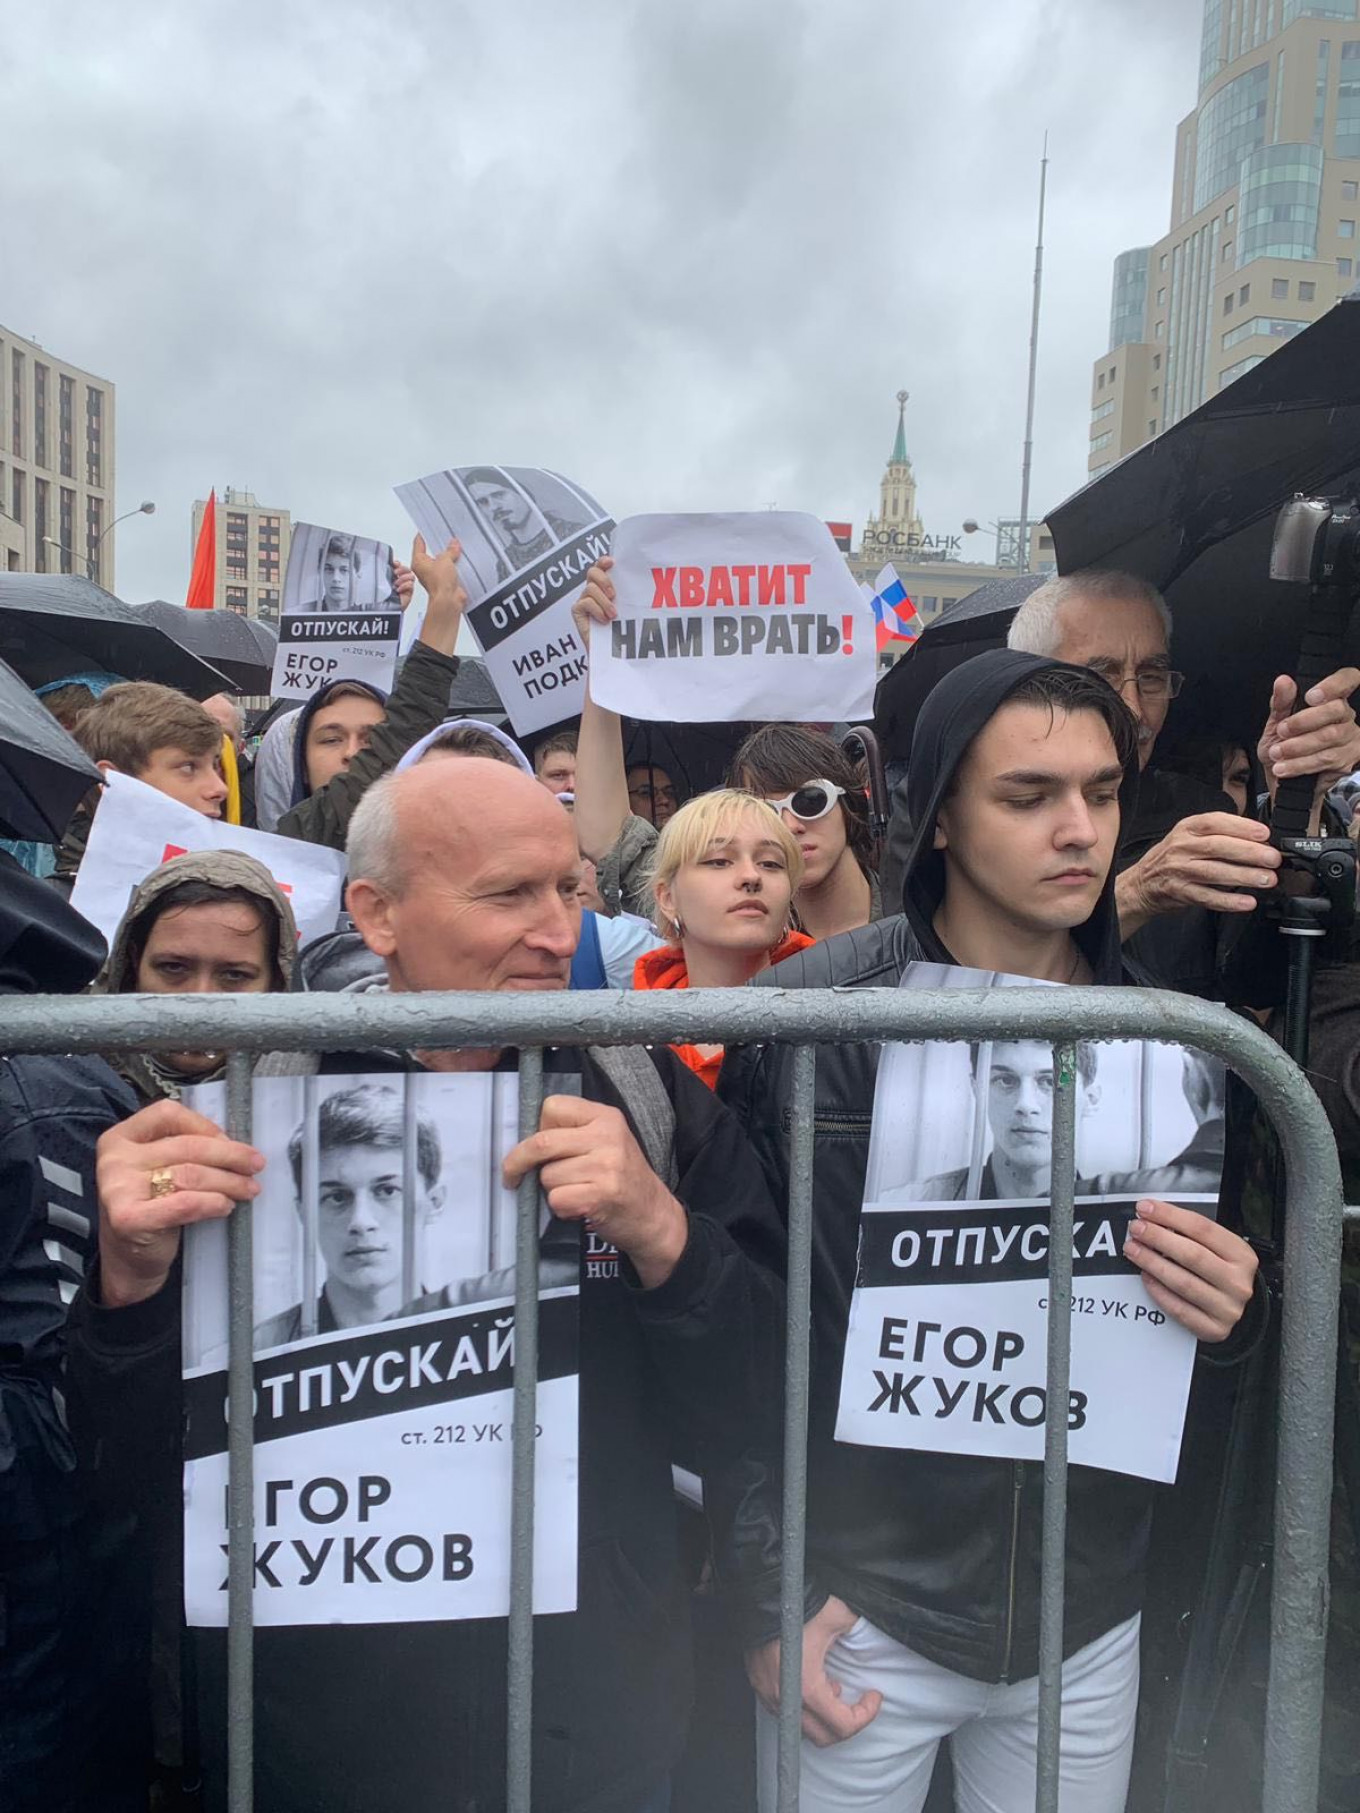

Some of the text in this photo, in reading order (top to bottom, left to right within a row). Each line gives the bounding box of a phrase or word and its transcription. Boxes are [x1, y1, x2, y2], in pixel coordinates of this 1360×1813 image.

[862, 529, 962, 550] РОСБАНК
[651, 563, 811, 609] ХВАТИТ
[290, 617, 390, 637] ОТПУСКАЙ!
[611, 612, 854, 660] НАМ ВРАТЬ!
[286, 653, 339, 674] ЕГОР
[511, 633, 578, 677] ИВАН
[891, 1219, 1134, 1268] ОТПУСА
[1101, 1299, 1128, 1320] УК
[1134, 1305, 1167, 1327] РФ
[879, 1317, 1025, 1371] ЕГОР
[224, 1316, 515, 1425] ТПУСКАЙ
[867, 1370, 1089, 1432] ЖУКОВ
[401, 1433, 428, 1446] ст.
[433, 1425, 467, 1444] 212
[472, 1423, 503, 1442] УК
[225, 1475, 392, 1530] ГОР
